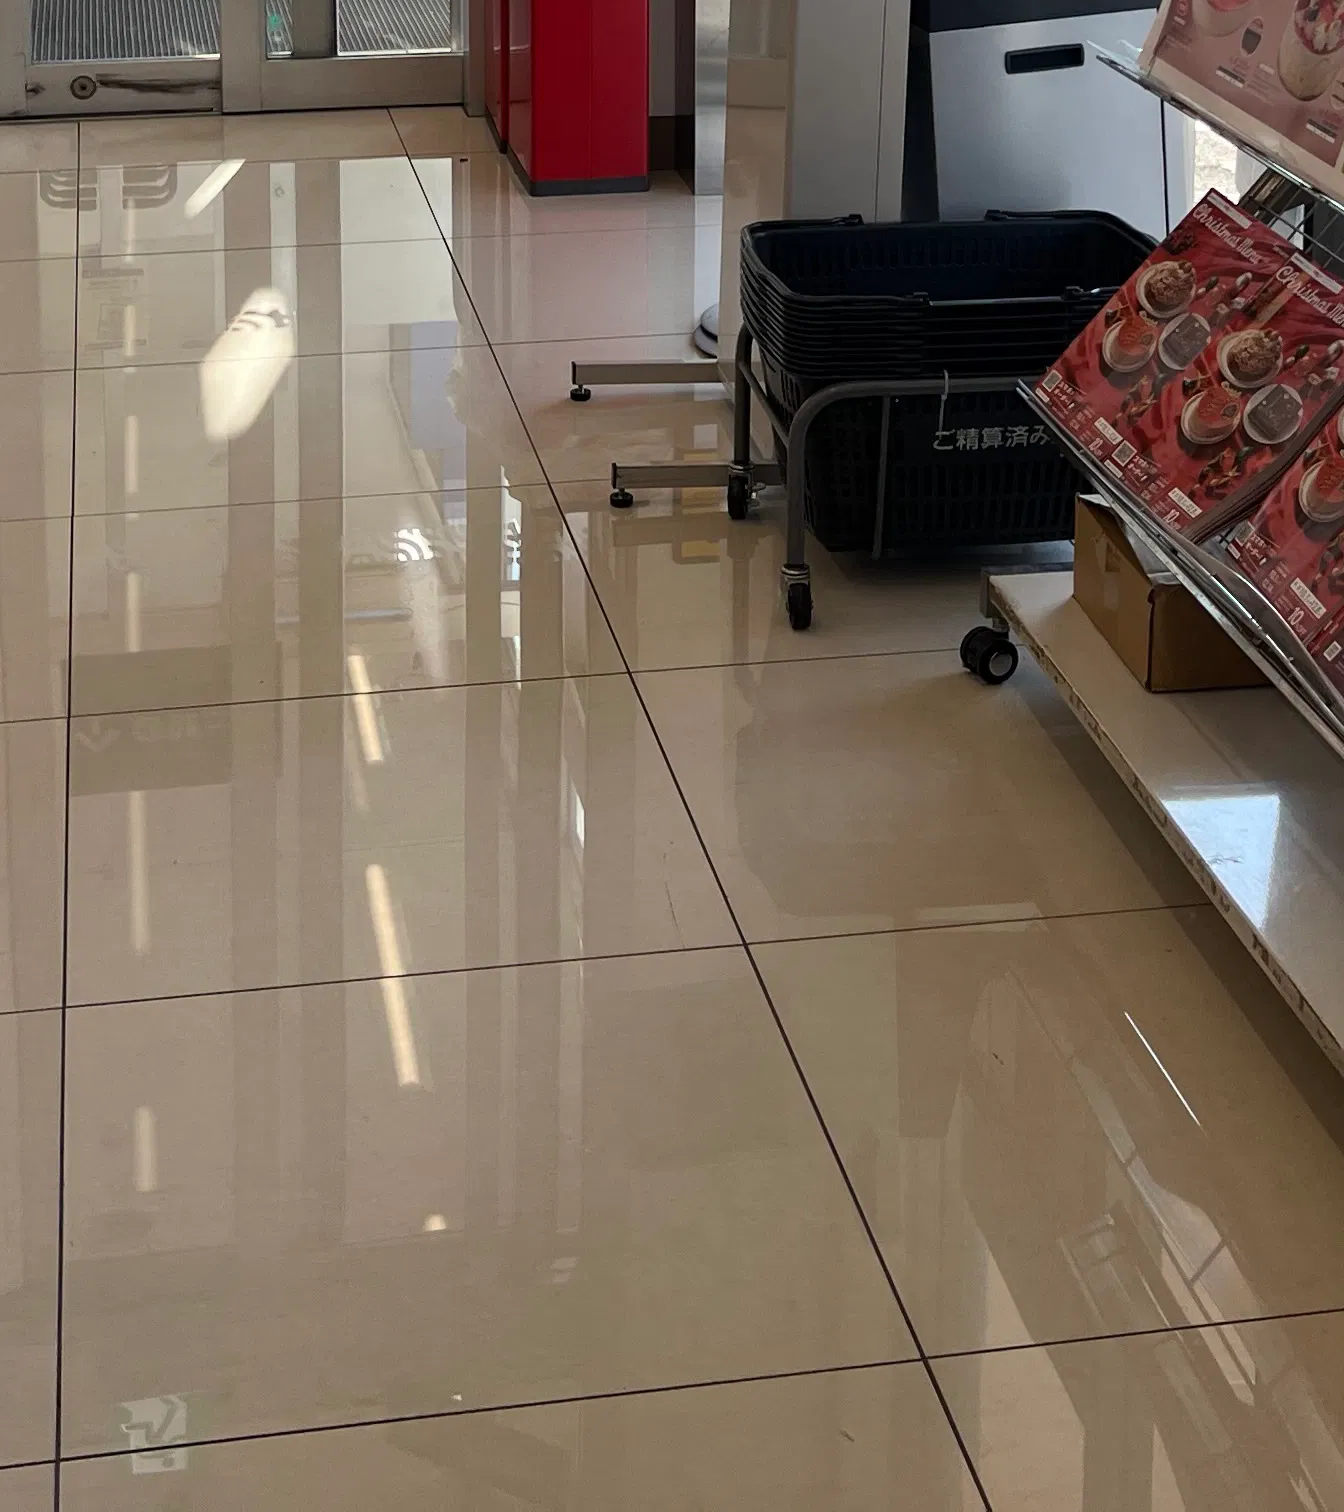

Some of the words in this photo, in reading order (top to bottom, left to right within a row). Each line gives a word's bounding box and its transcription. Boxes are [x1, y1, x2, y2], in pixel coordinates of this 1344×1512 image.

[1192, 203, 1239, 249] Christmas
[1275, 265, 1329, 316] Christmas
[932, 425, 1059, 451] ご精算済み
